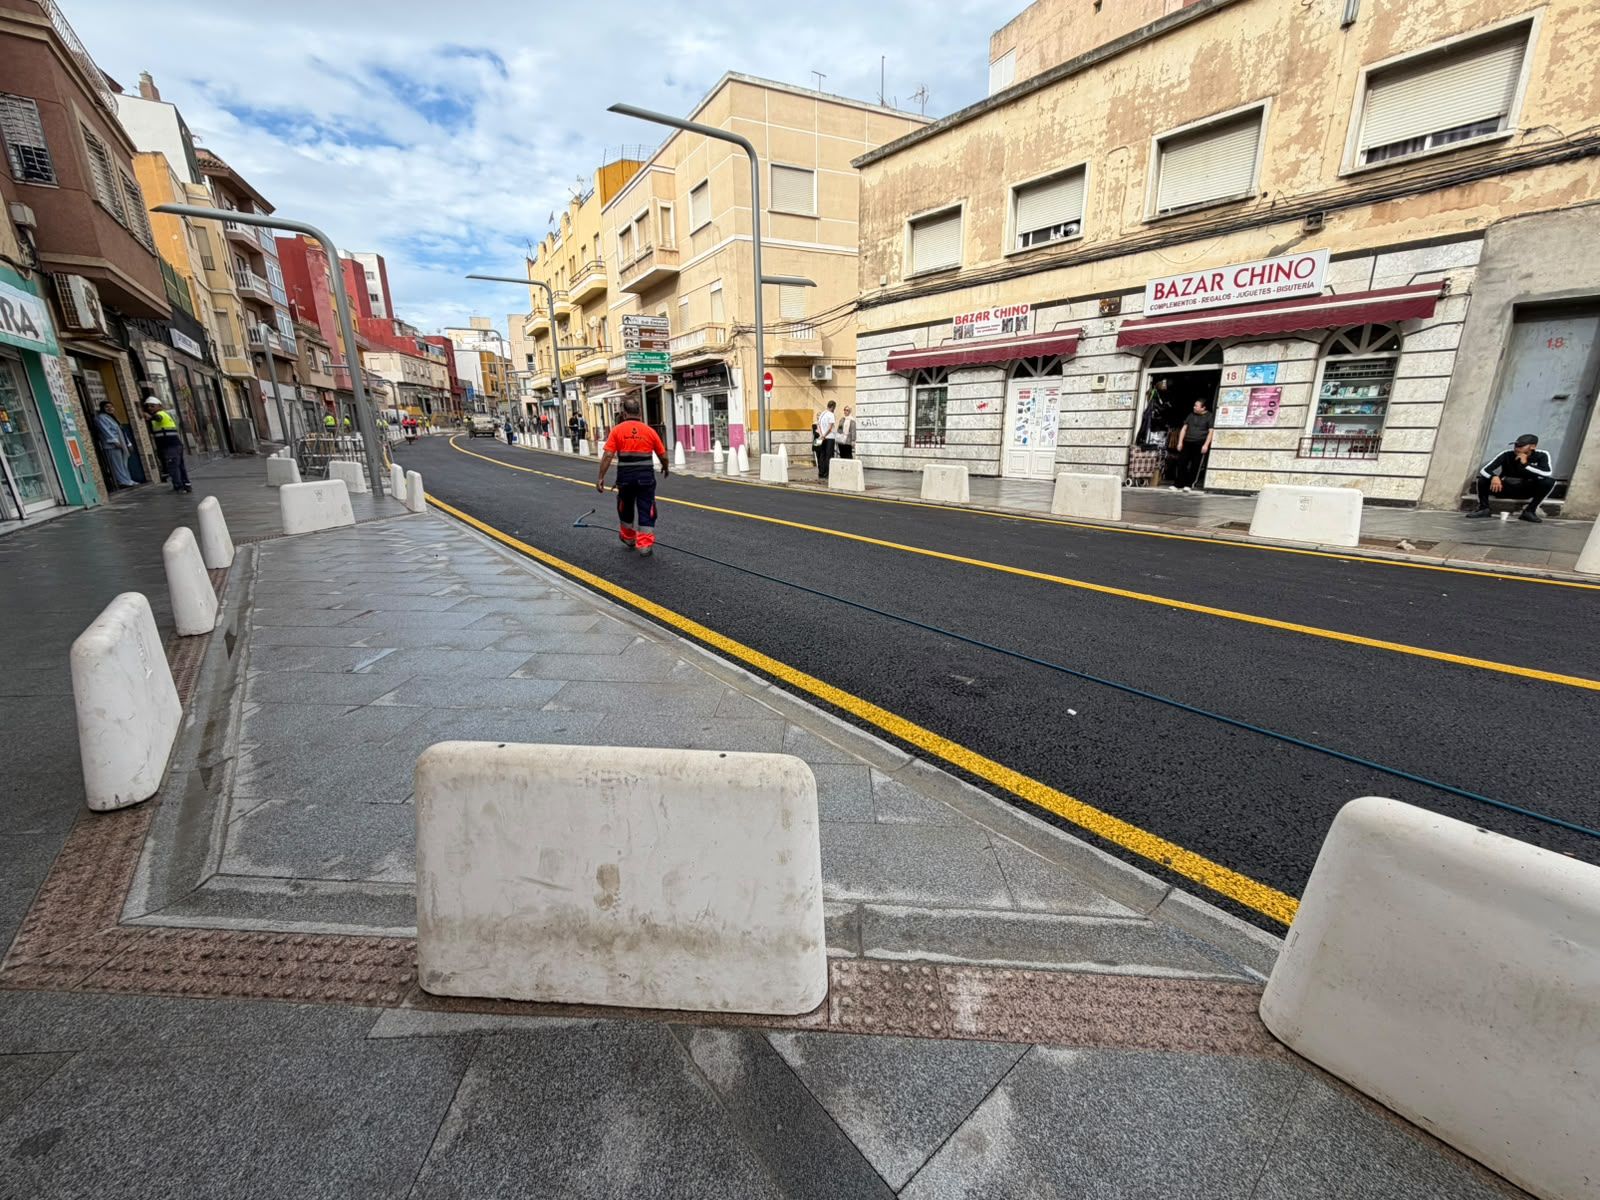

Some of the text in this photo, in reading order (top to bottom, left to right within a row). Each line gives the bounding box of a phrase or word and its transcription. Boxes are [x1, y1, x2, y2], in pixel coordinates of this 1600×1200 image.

[1153, 257, 1316, 301] BAZAR CHINO
[1149, 280, 1315, 311] COMPLEMENTOS REGALOS JUGUETES BISUTERÍA
[0, 296, 40, 340] RA
[954, 304, 1029, 325] BAZAR CHINO
[1546, 336, 1564, 349] 18
[1226, 371, 1238, 381] 18
